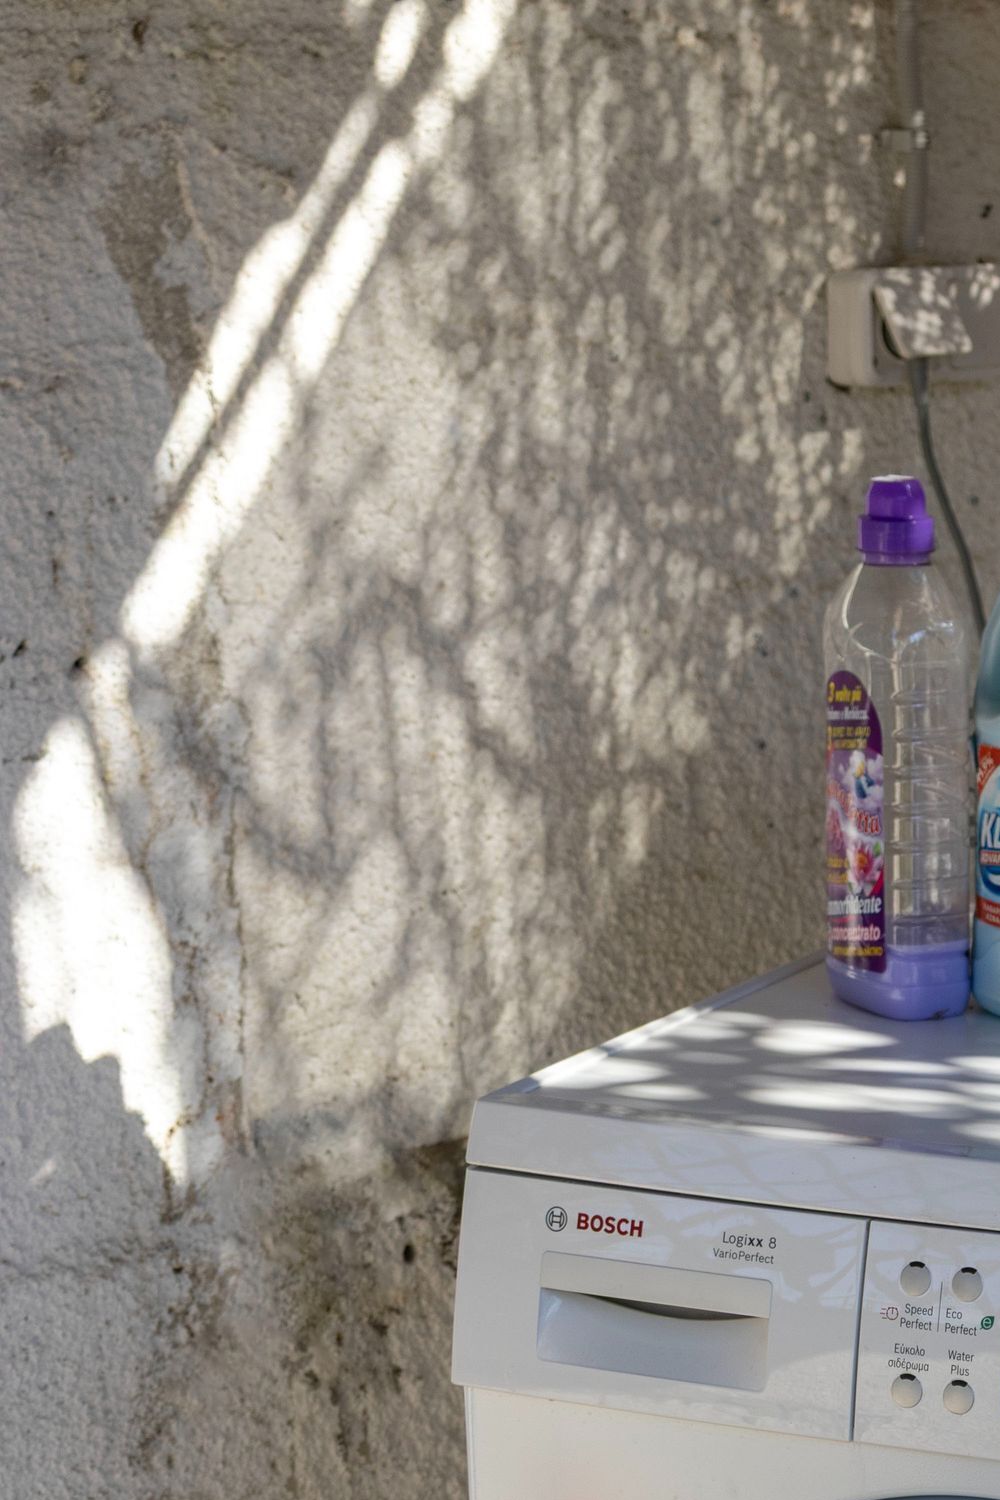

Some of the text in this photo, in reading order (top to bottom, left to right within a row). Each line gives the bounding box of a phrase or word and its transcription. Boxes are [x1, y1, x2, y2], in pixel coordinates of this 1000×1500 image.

[576, 1212, 644, 1238] BOSCH
[722, 1231, 777, 1249] Logixx 8
[713, 1247, 774, 1265] VarioPerfect
[905, 1303, 934, 1316] Speed
[946, 1308, 963, 1320] Eco
[900, 1317, 932, 1331] Perfect
[945, 1323, 977, 1336] Perfect
[894, 1343, 926, 1357] Εύκολο
[948, 1350, 975, 1362] Water
[888, 1357, 929, 1372] σιδέρωμα
[950, 1364, 970, 1376] Plus
